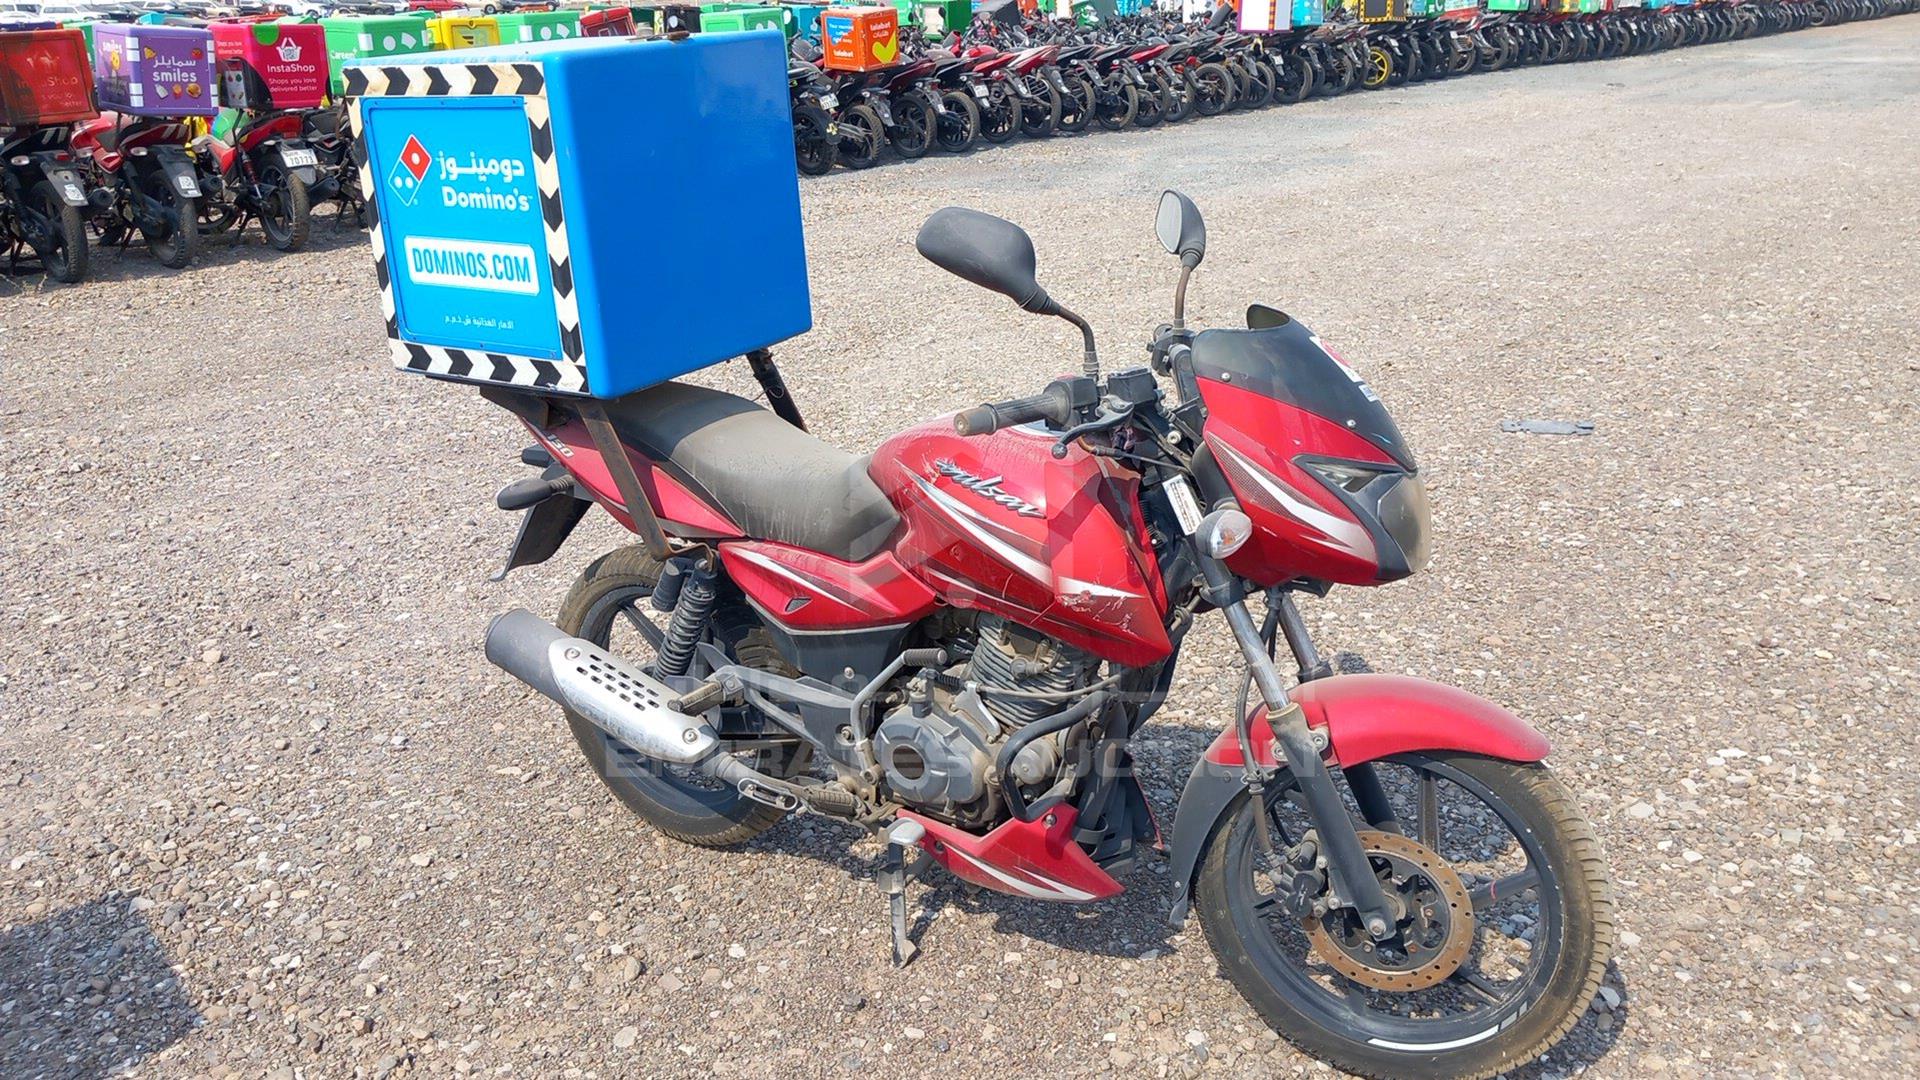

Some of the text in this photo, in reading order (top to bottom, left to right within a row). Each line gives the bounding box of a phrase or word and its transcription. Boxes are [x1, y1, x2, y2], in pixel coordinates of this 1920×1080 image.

[152, 68, 197, 82] smiles
[267, 64, 316, 74] InstaShop
[441, 186, 530, 212] Domino's
[412, 247, 531, 283] DOMINOS.COM
